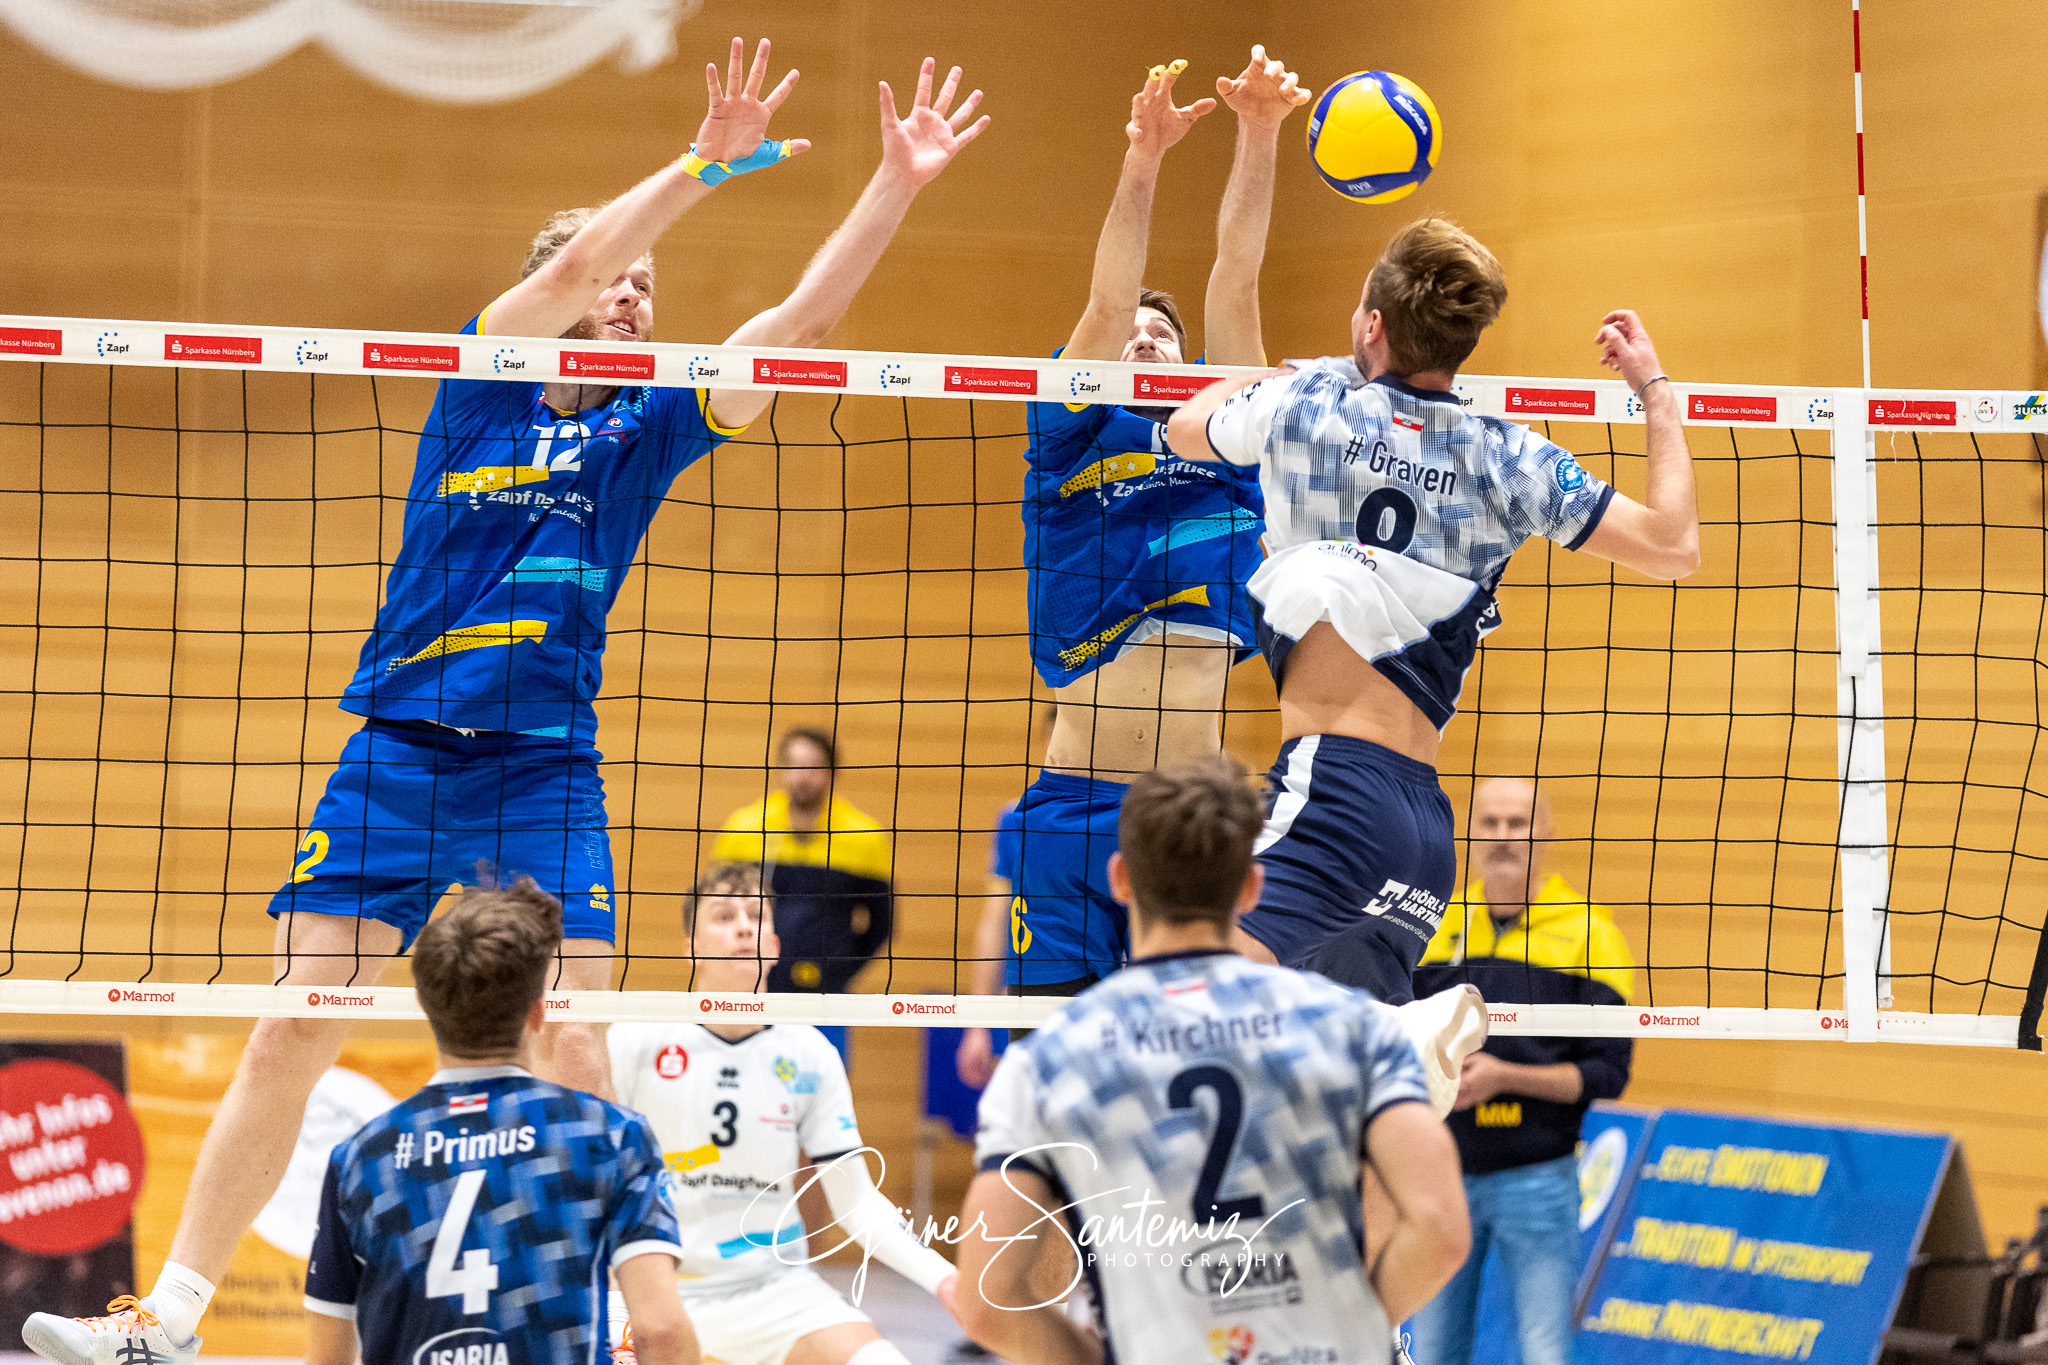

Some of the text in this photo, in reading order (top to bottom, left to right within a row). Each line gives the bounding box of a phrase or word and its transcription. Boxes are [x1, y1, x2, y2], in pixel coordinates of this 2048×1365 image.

[22, 339, 55, 350] Nürnberg
[107, 344, 129, 353] Zapf
[185, 346, 256, 358] Sparkasse Nürnberg
[306, 352, 328, 361] Zapf
[384, 354, 453, 366] Sparkasse Nürnberg
[503, 360, 526, 369] Zapf
[580, 362, 648, 374] Sparkasse Nürnberg
[697, 367, 719, 377] Zapf
[773, 370, 841, 382] Sparkasse Nürnberg
[964, 377, 1031, 390] Sparkasse Nürnberg
[1079, 383, 1101, 393] Zapf
[1153, 385, 1187, 395] Sparkasse
[1457, 397, 1473, 407] apf
[1524, 399, 1589, 410] Sparkasse Nürnberg
[1635, 403, 1646, 412] Za
[1707, 406, 1771, 416] Sparkasse Nürnberg
[1816, 409, 1834, 419] Zap
[1887, 410, 1920, 420] Sparkasse
[2013, 406, 2046, 415] HUCK
[532, 423, 591, 472] 12
[1343, 435, 1457, 497] # Graven
[486, 490, 532, 506] Zapf
[1011, 896, 1032, 954] 6
[122, 990, 175, 1002] Marmot
[322, 994, 373, 1006] Marmot
[545, 998, 570, 1009] mot
[714, 1001, 764, 1011] Marmot
[906, 1003, 956, 1014] Marmot
[1488, 1012, 1517, 1022] rmot
[1652, 1015, 1700, 1026] Marmot
[1133, 1010, 1284, 1053] Kirchner
[711, 1101, 739, 1147] 3
[394, 1125, 536, 1169] # Primus
[1167, 1065, 1265, 1224] 2
[426, 1169, 499, 1315] 4
[431, 1343, 510, 1365] ISARIA
